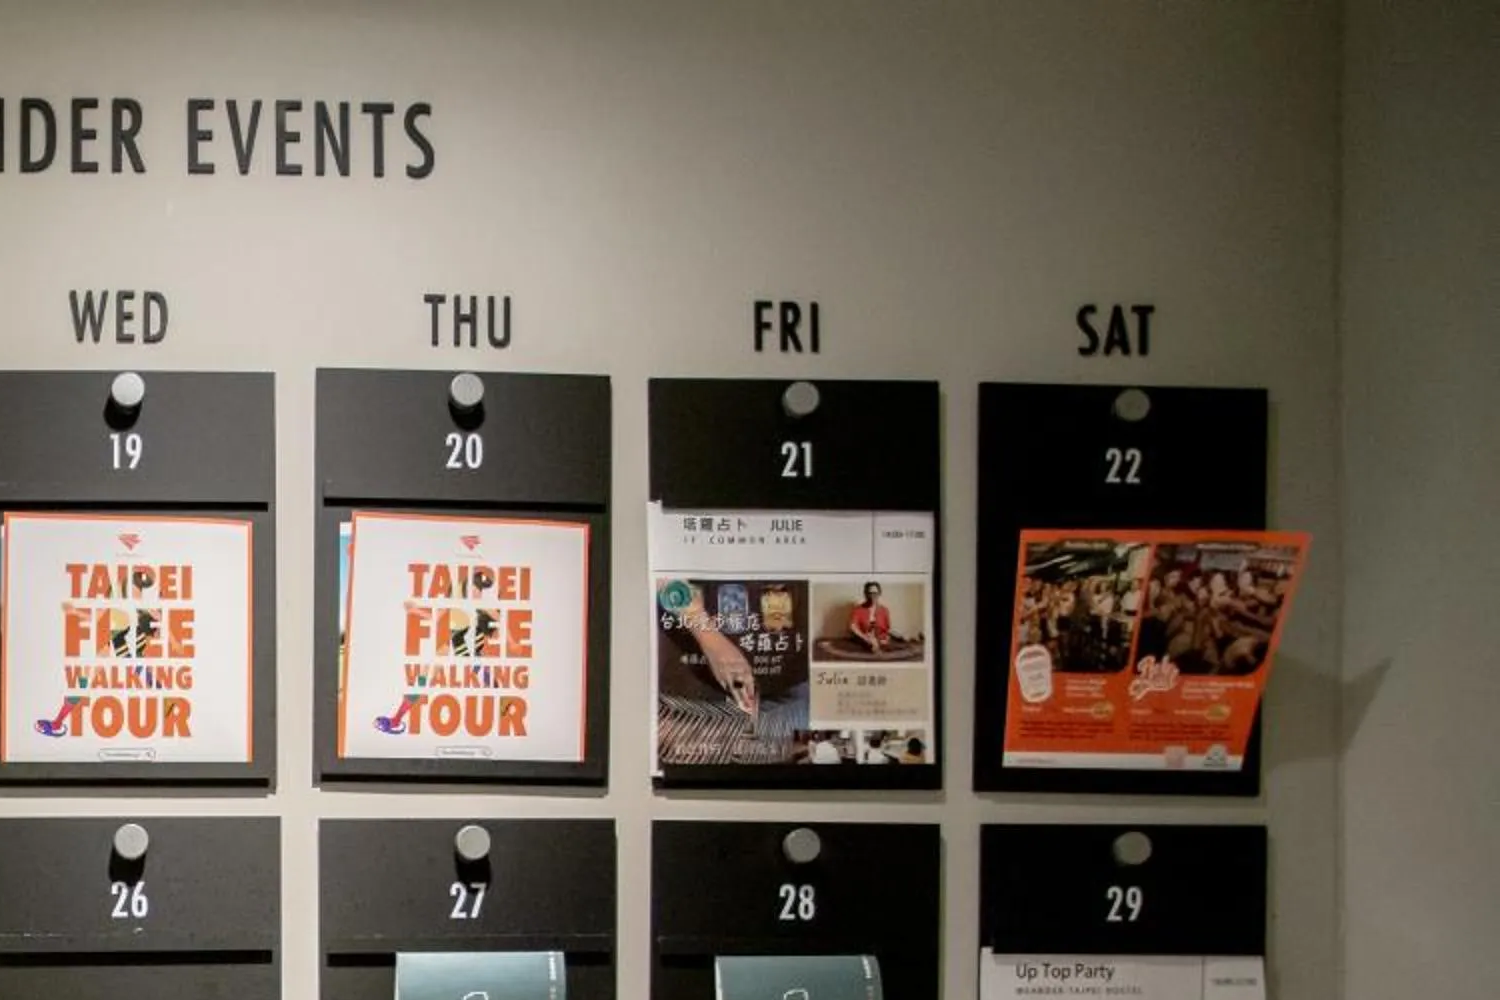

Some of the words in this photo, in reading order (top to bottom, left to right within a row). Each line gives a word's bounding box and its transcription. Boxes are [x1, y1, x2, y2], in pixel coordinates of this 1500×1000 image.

[187, 98, 435, 180] EVENTS
[68, 289, 169, 345] WED
[423, 293, 512, 350] THU
[753, 300, 820, 354] FRI
[1076, 303, 1156, 357] SAT
[109, 433, 143, 470] 19
[445, 432, 483, 469] 20
[781, 441, 812, 478] 21
[1105, 447, 1142, 484] 22
[770, 519, 803, 532] JULIE
[65, 563, 193, 600] TAIPEI
[407, 563, 532, 601] TAIPEI
[64, 608, 195, 659] FREE
[404, 608, 533, 659] FREE
[65, 665, 193, 690] WALKING
[404, 664, 529, 689] WALKING
[63, 695, 192, 738] TOUR
[403, 693, 528, 737] TOUR
[110, 880, 149, 918] 26
[449, 881, 486, 919] 27
[779, 883, 816, 921] 28
[1106, 885, 1143, 922] 29
[1015, 963, 1037, 981] Up
[1042, 963, 1071, 980] Top
[1074, 963, 1115, 981] Party
